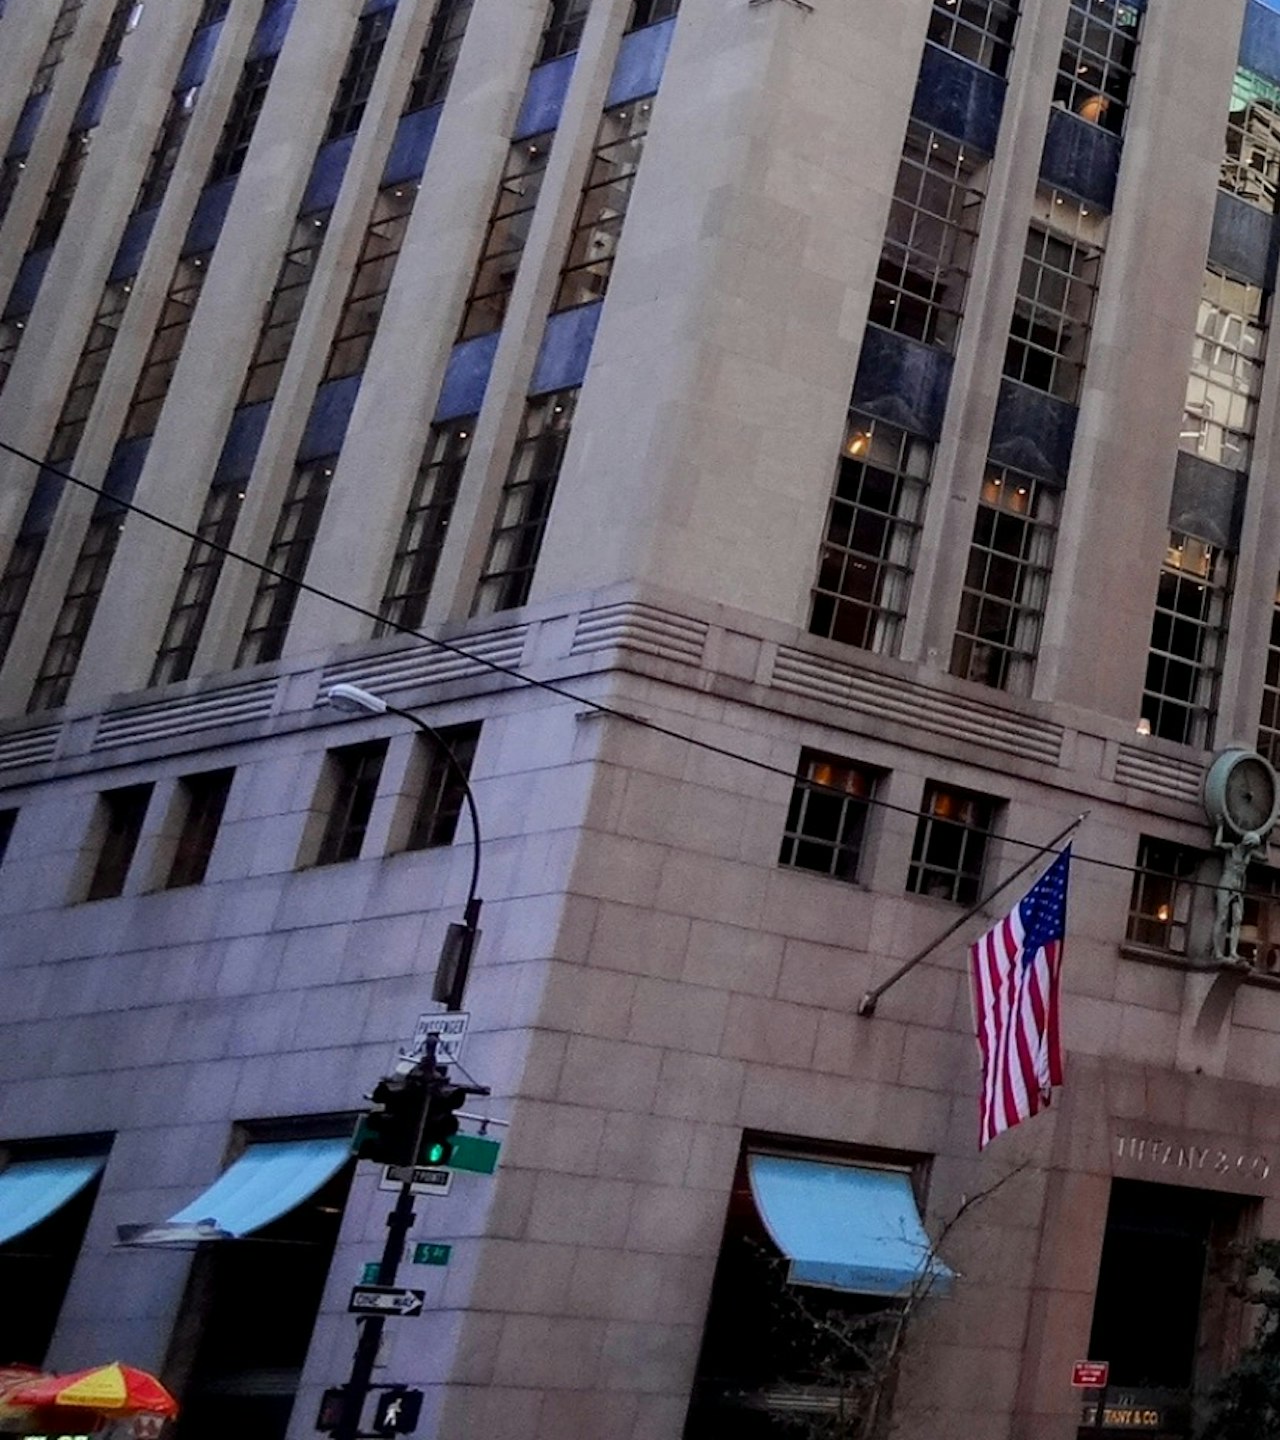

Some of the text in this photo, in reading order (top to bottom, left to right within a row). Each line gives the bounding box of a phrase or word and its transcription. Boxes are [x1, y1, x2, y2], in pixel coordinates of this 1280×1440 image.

[419, 1020, 465, 1034] PASSENGER
[421, 1246, 429, 1262] 5
[355, 1294, 416, 1308] ONE WAY
